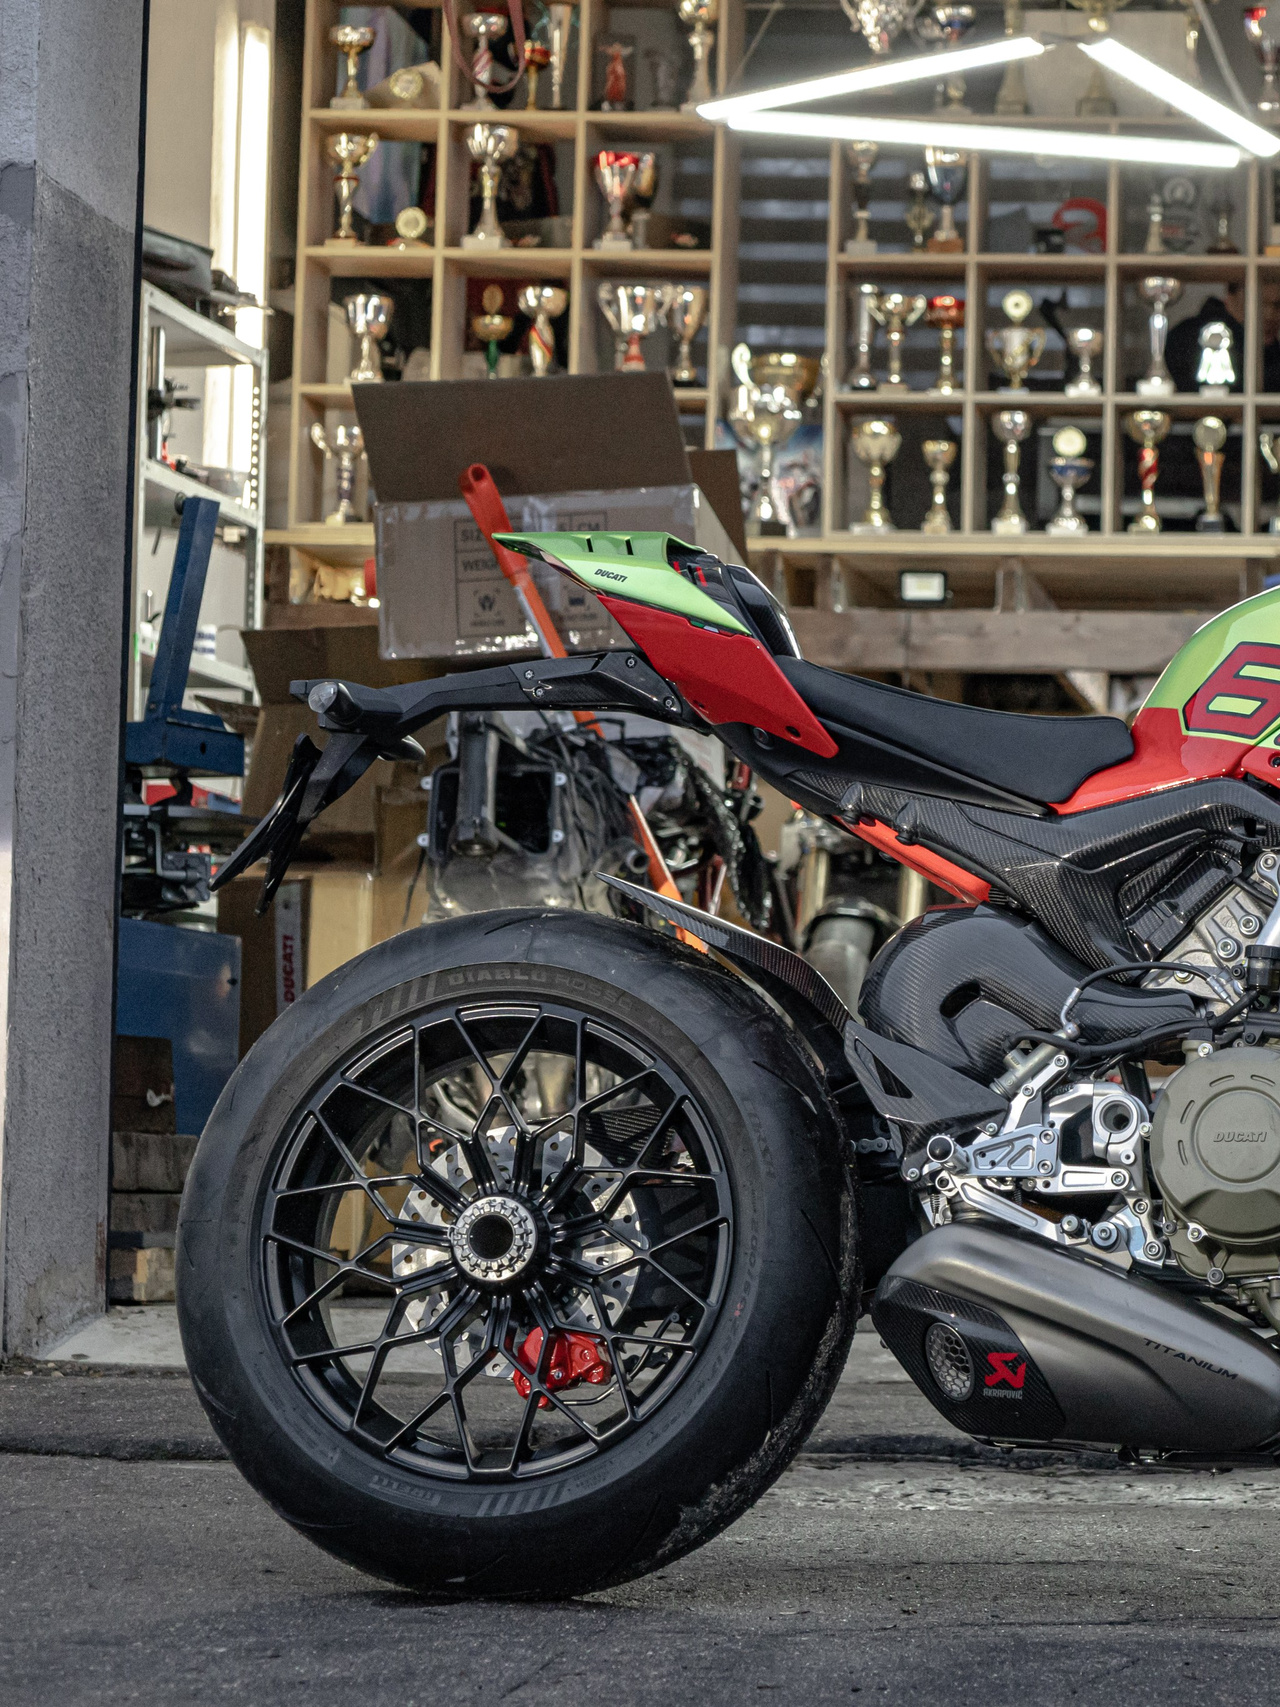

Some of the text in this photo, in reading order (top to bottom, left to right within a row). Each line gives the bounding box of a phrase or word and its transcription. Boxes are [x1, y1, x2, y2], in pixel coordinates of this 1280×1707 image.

[594, 568, 628, 583] DUCATI
[1212, 1131, 1268, 1143] DUCATI
[1143, 1337, 1239, 1380] TITANIUM
